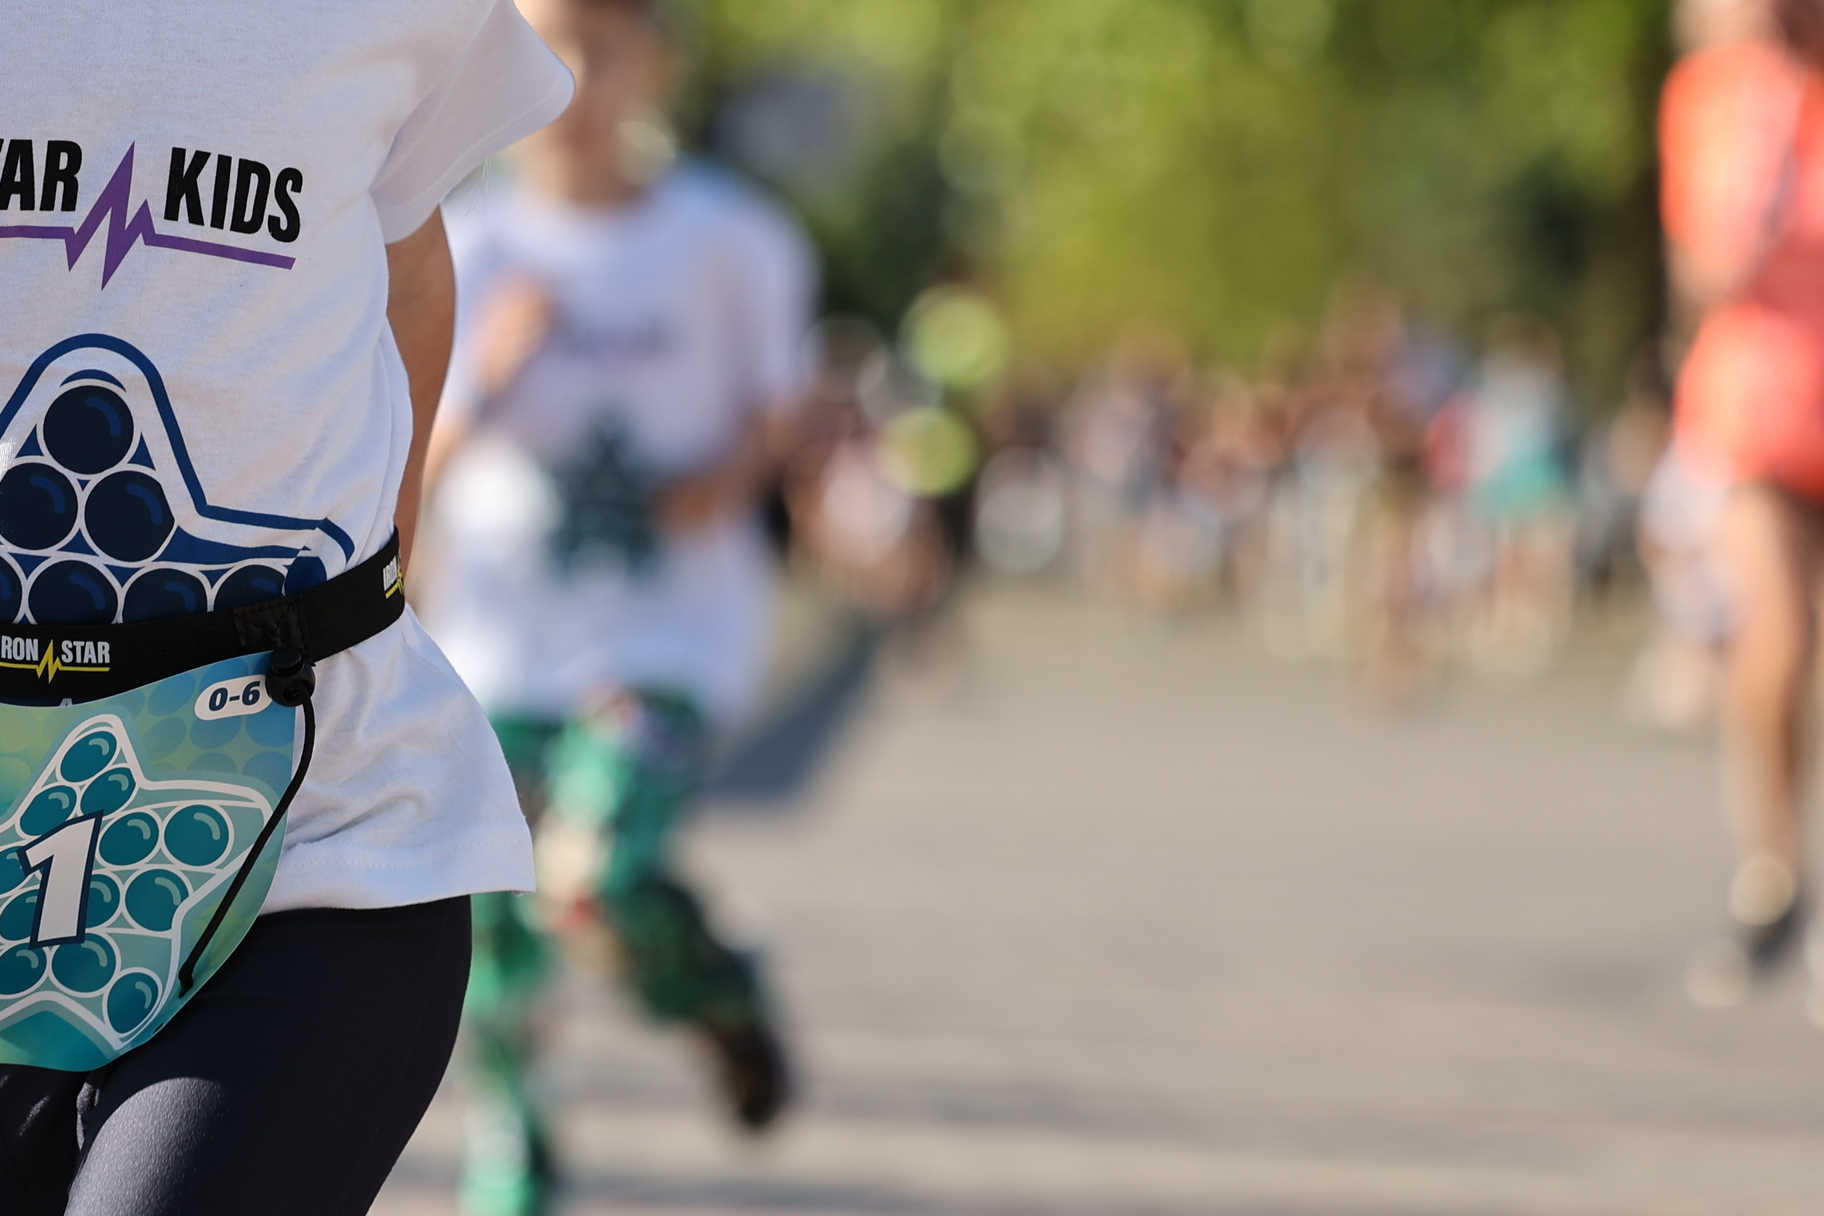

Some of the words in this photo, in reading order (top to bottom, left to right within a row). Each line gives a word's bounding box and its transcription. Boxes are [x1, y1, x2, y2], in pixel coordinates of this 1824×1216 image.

[163, 146, 304, 244] KIDS
[61, 640, 111, 664] STAR
[208, 680, 261, 712] 0-6
[16, 809, 104, 950] 1
